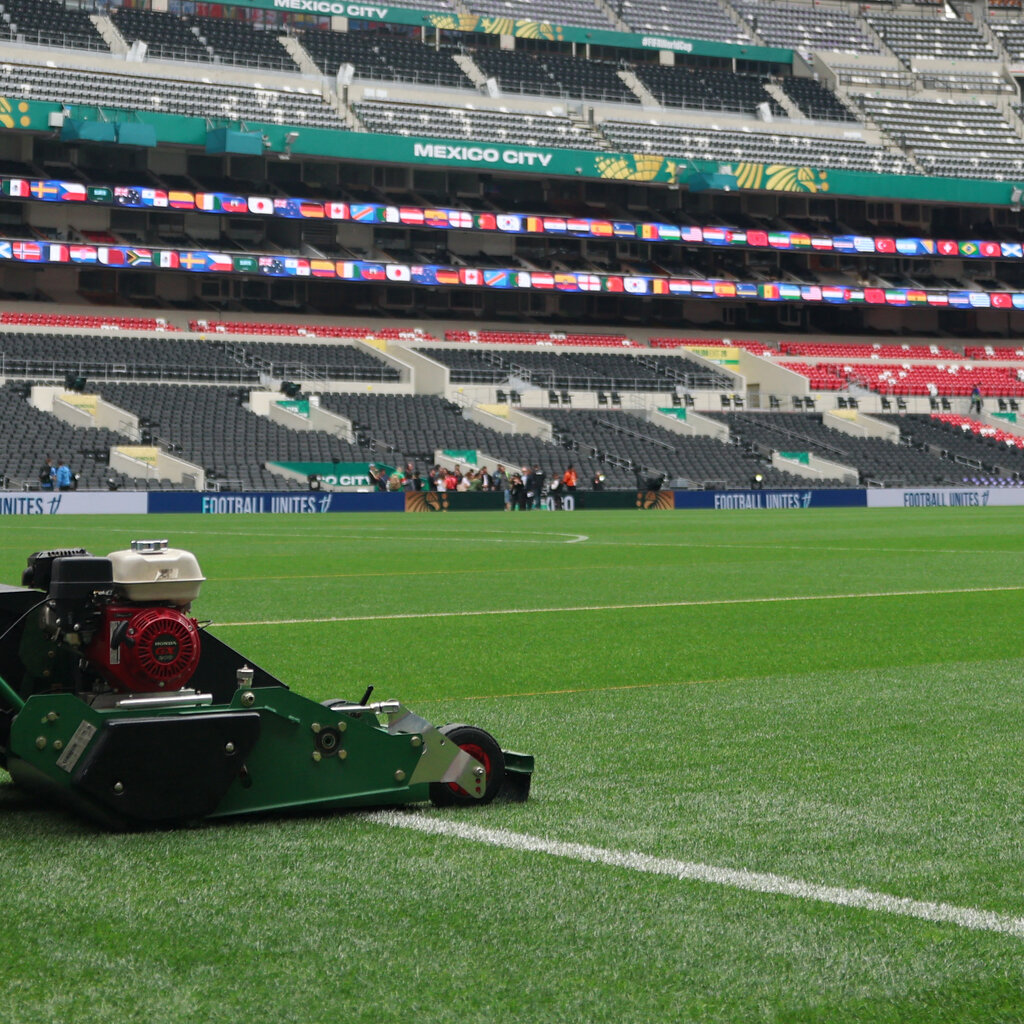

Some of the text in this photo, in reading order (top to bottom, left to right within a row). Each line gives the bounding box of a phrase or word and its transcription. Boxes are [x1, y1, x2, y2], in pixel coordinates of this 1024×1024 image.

[347, 5, 389, 19] CITY
[413, 142, 553, 167] MEXICO CITY
[202, 497, 316, 514] FOOTBALL UNITES
[714, 494, 801, 509] FOOTBALL UNITES
[904, 492, 979, 507] FOOTBALL UNITES
